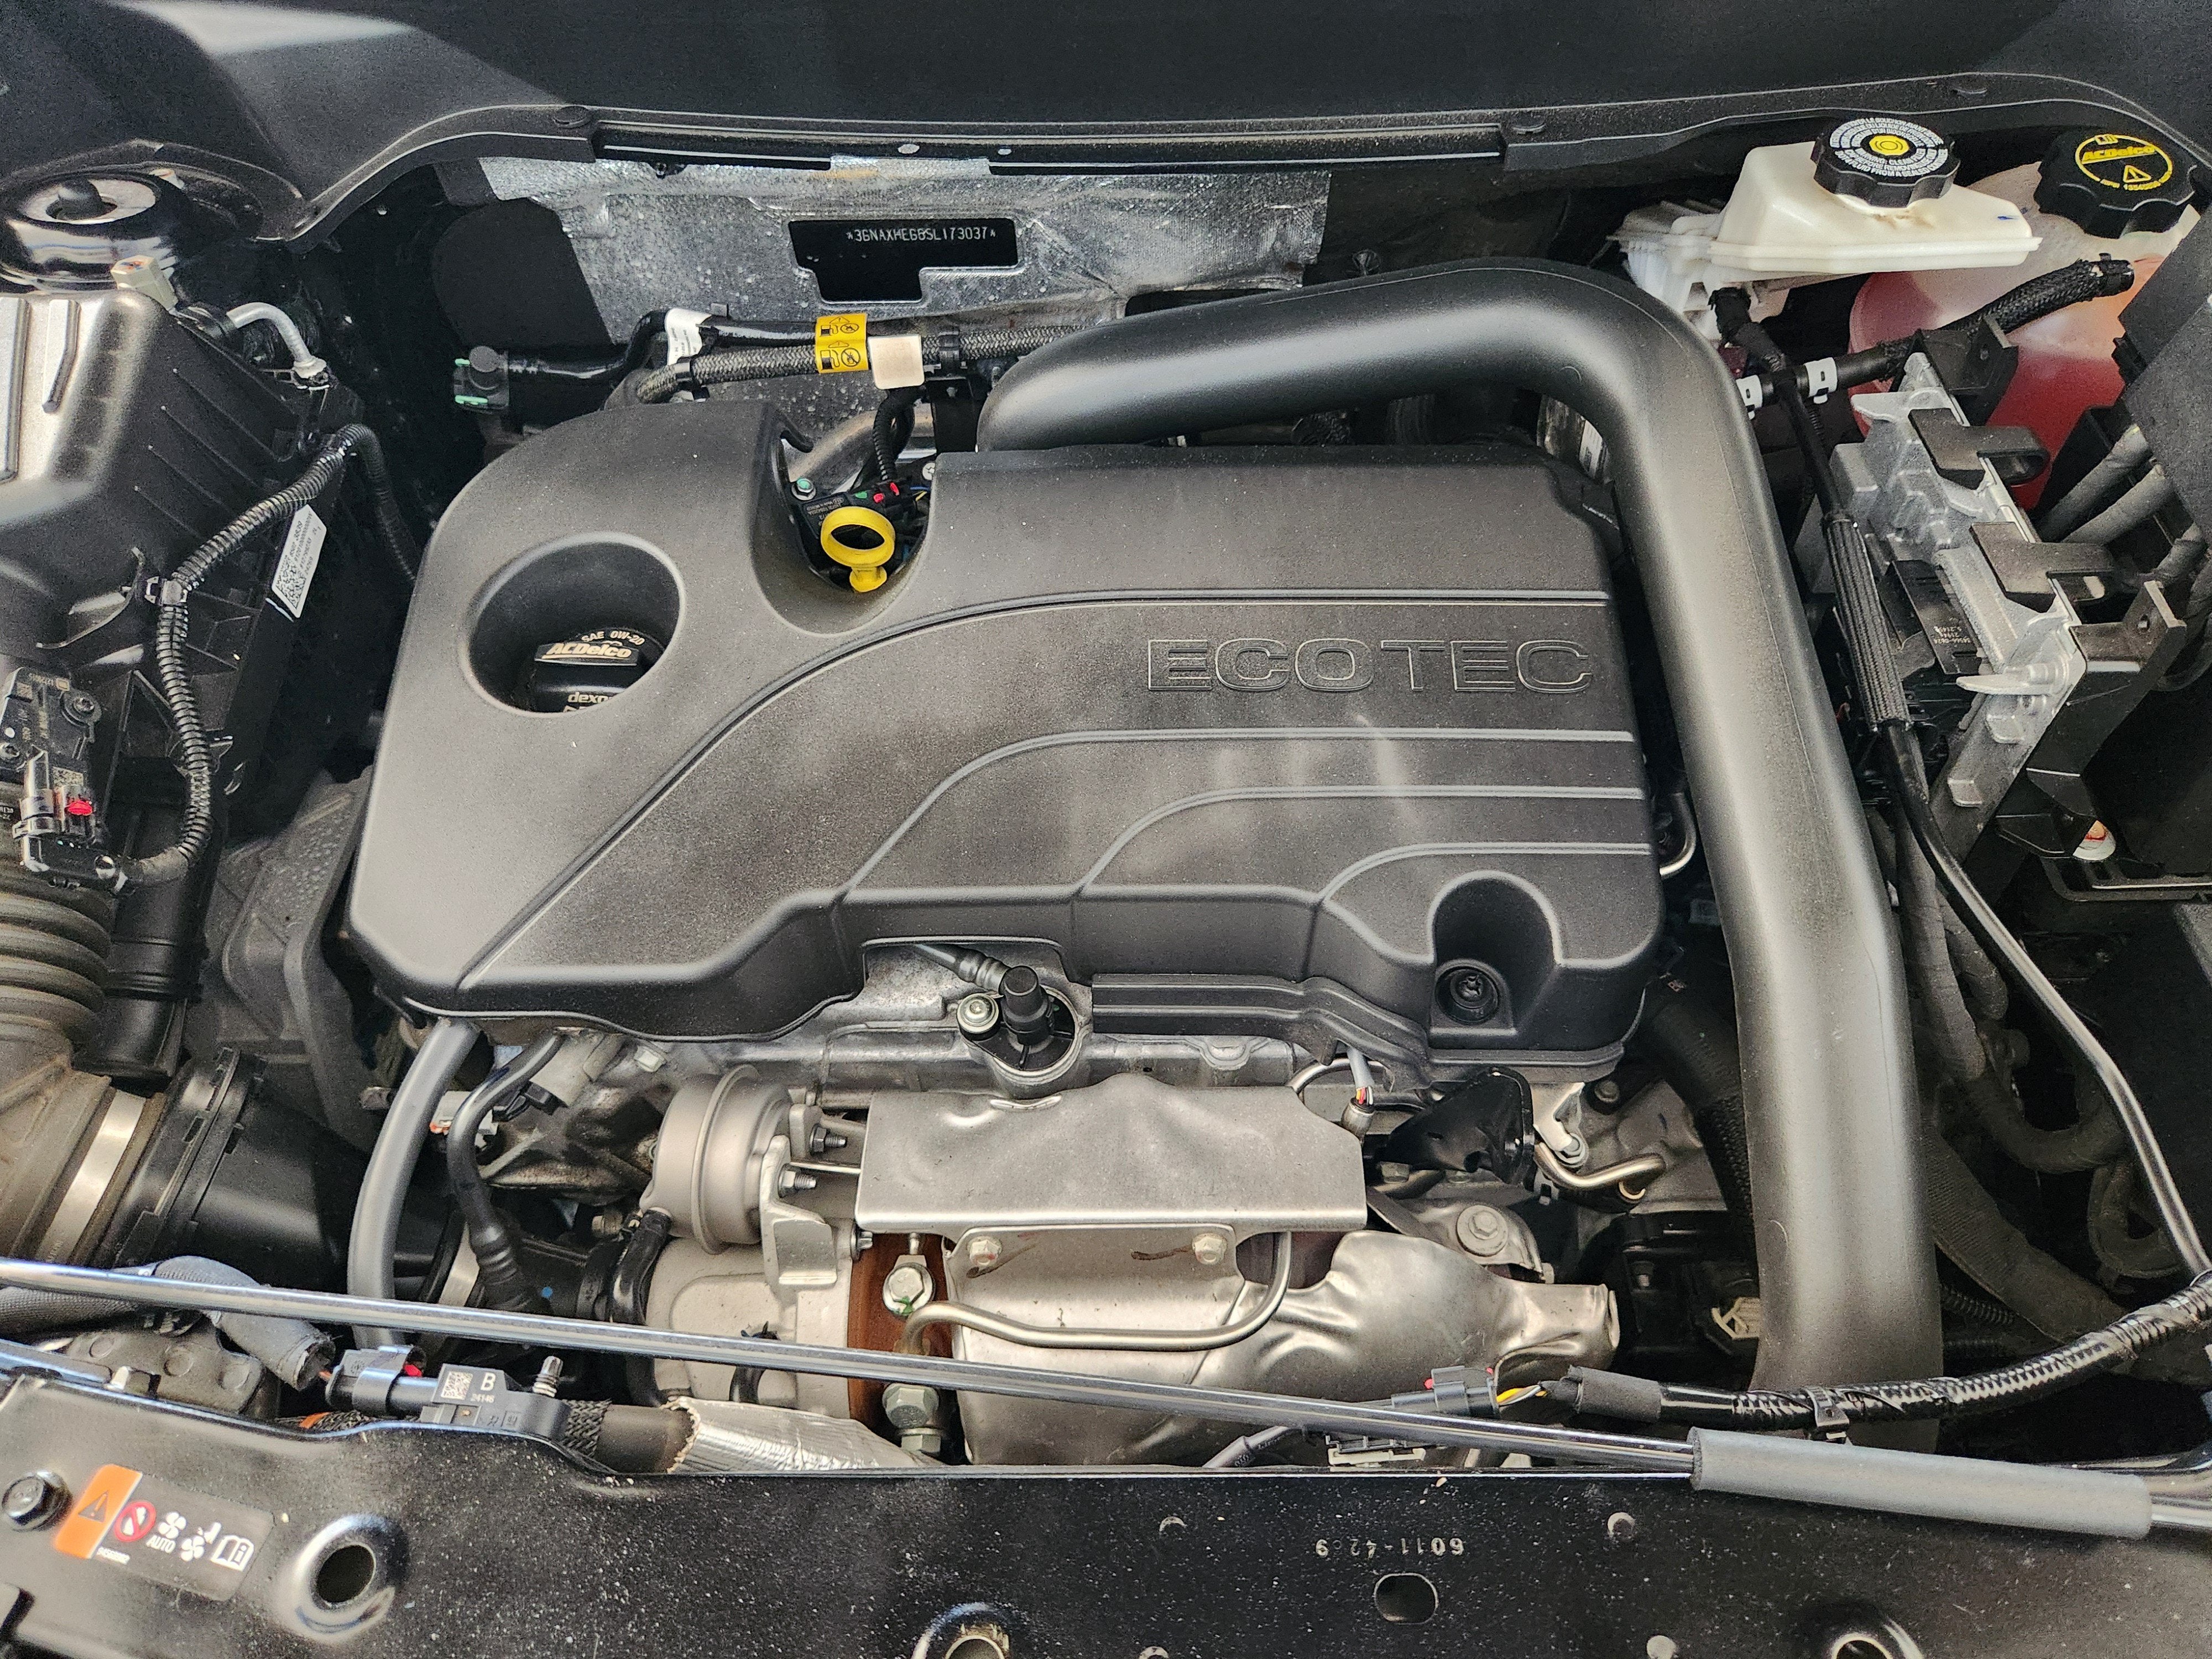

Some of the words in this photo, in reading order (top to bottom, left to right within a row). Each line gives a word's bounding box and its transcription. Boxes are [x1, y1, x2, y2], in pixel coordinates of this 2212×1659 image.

[2082, 146, 2155, 162] ACDelco
[581, 631, 605, 642] SAE
[609, 630, 645, 646] 0W-20
[546, 642, 632, 659] ACDelco
[1147, 639, 1592, 692] ECOTEC
[480, 1372, 496, 1391] B
[146, 1535, 176, 1553] AUTO
